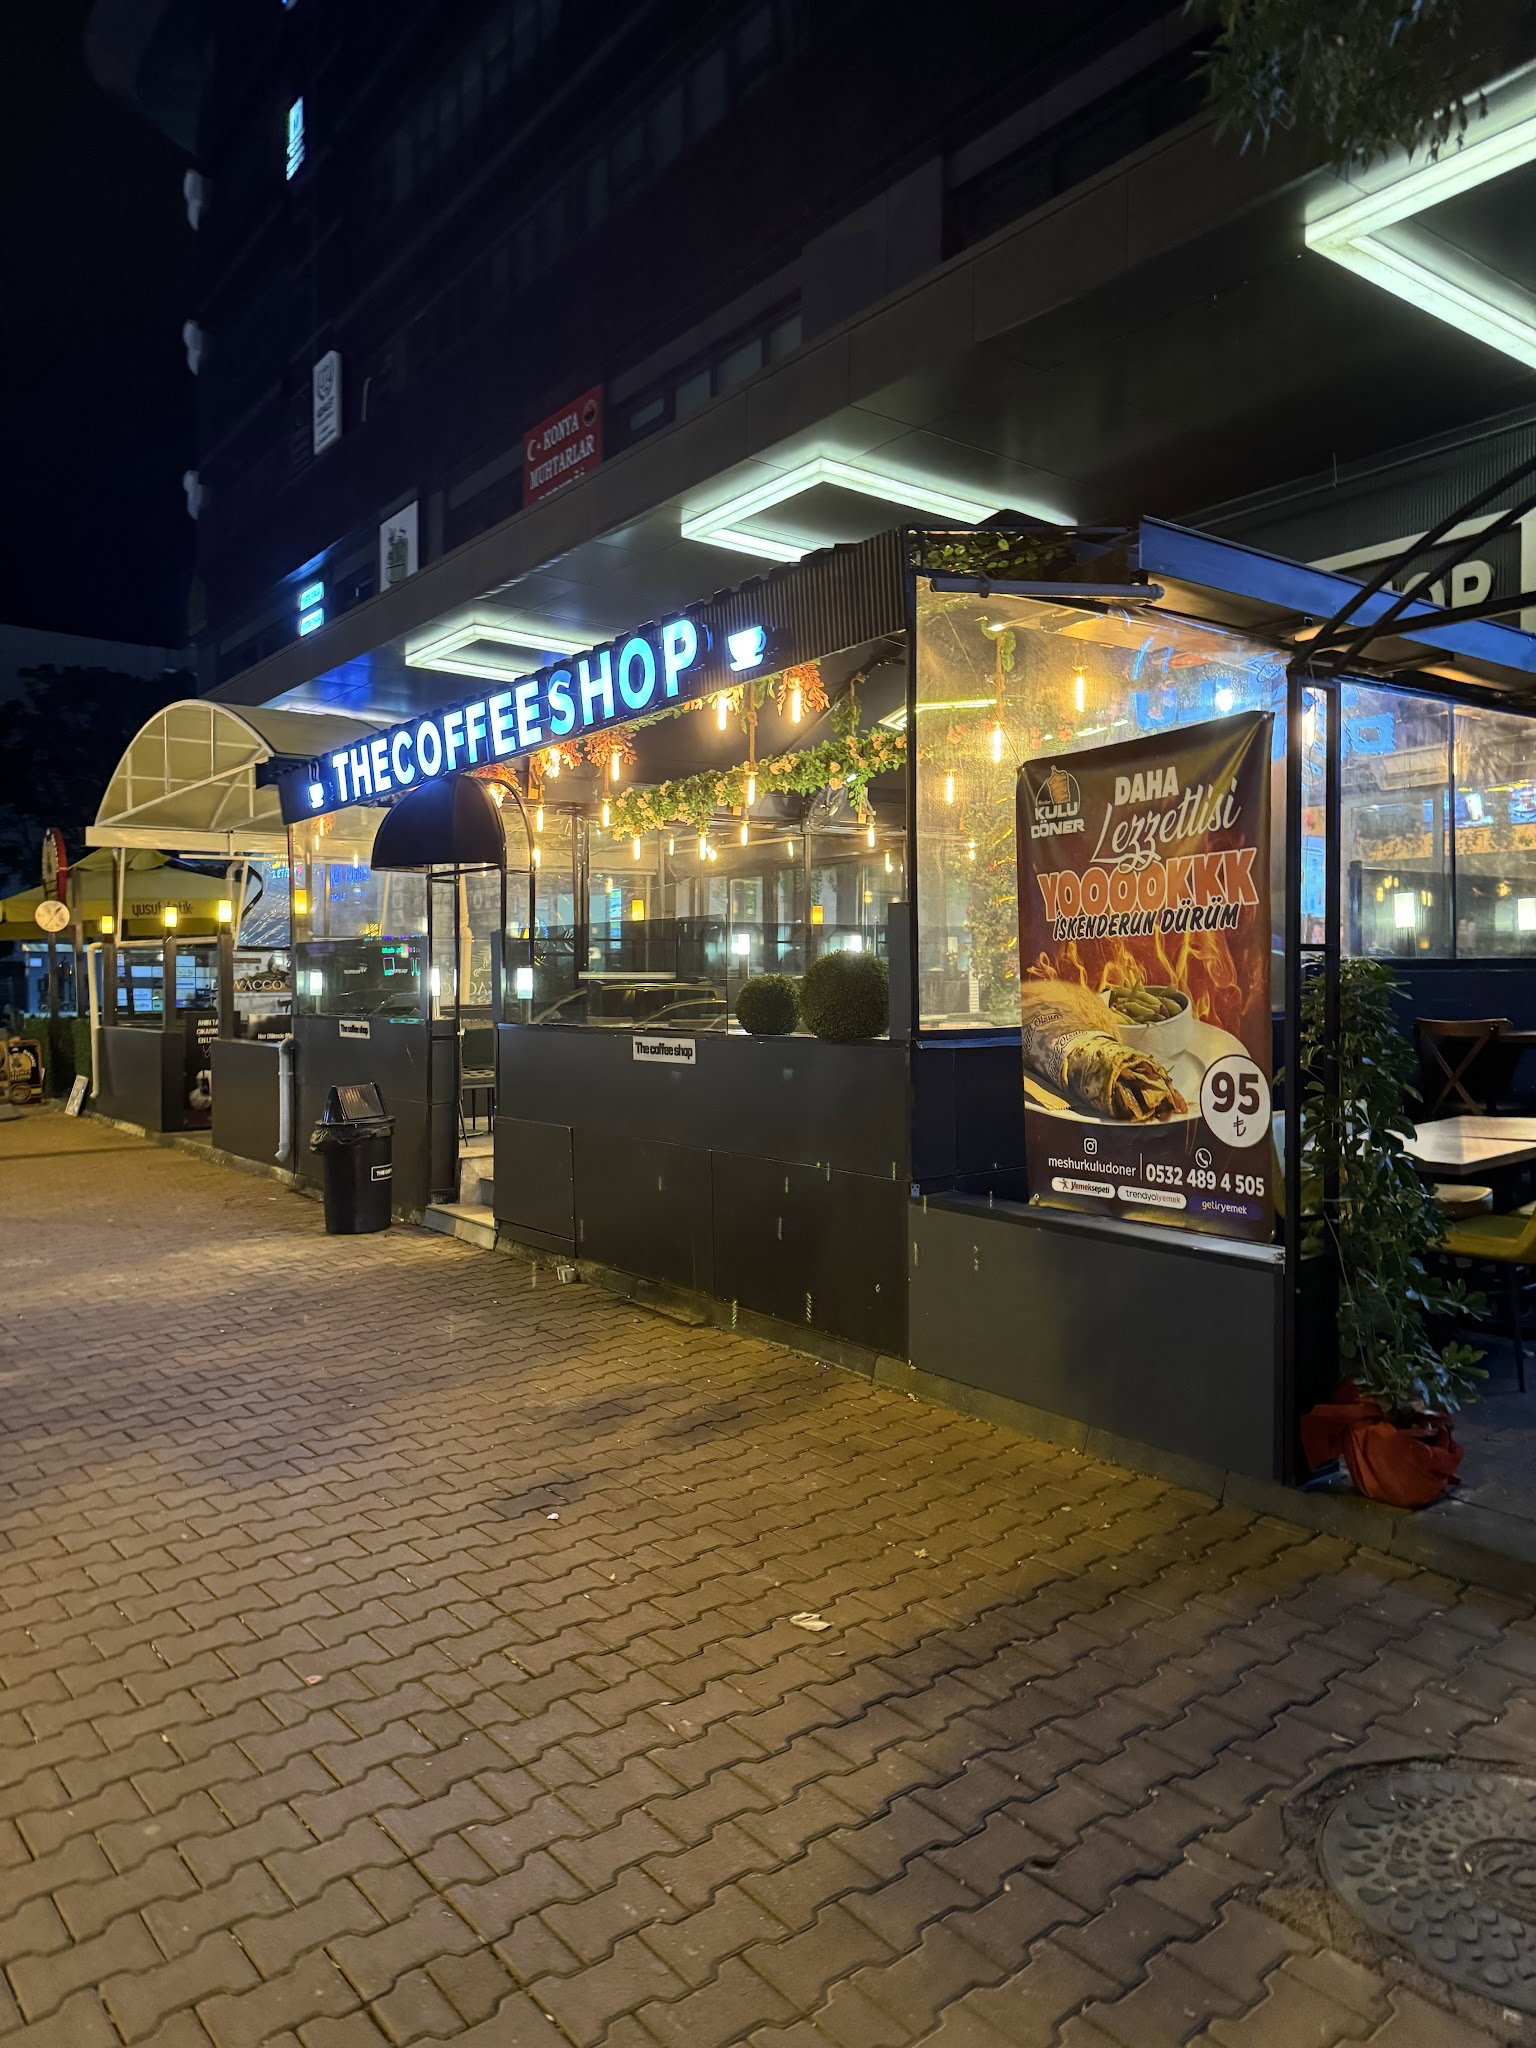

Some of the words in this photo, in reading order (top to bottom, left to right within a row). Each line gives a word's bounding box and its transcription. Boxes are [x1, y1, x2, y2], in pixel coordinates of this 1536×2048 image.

[543, 411, 580, 451] KONYA
[529, 434, 595, 490] MUHTARLAR
[1114, 766, 1179, 806] DAHA
[1030, 818, 1086, 839] DÖNER
[1034, 801, 1078, 821] KULU
[1089, 777, 1242, 874] Lezzetlisi
[1036, 847, 1260, 922] YOOOOKKK
[1053, 907, 1160, 941] İSKENDERUN
[1160, 896, 1241, 934] DÜRÜM
[635, 1041, 649, 1054] The
[650, 1042, 673, 1055] coffee
[674, 1043, 693, 1060] shop
[1211, 1071, 1260, 1115] 95
[1048, 1156, 1137, 1177] meshurkuludoner
[1145, 1163, 1183, 1186] 0532
[1186, 1168, 1217, 1190] 489
[1220, 1173, 1231, 1192] 4
[1234, 1175, 1265, 1197] 505
[1201, 1199, 1248, 1215] getiryemek
